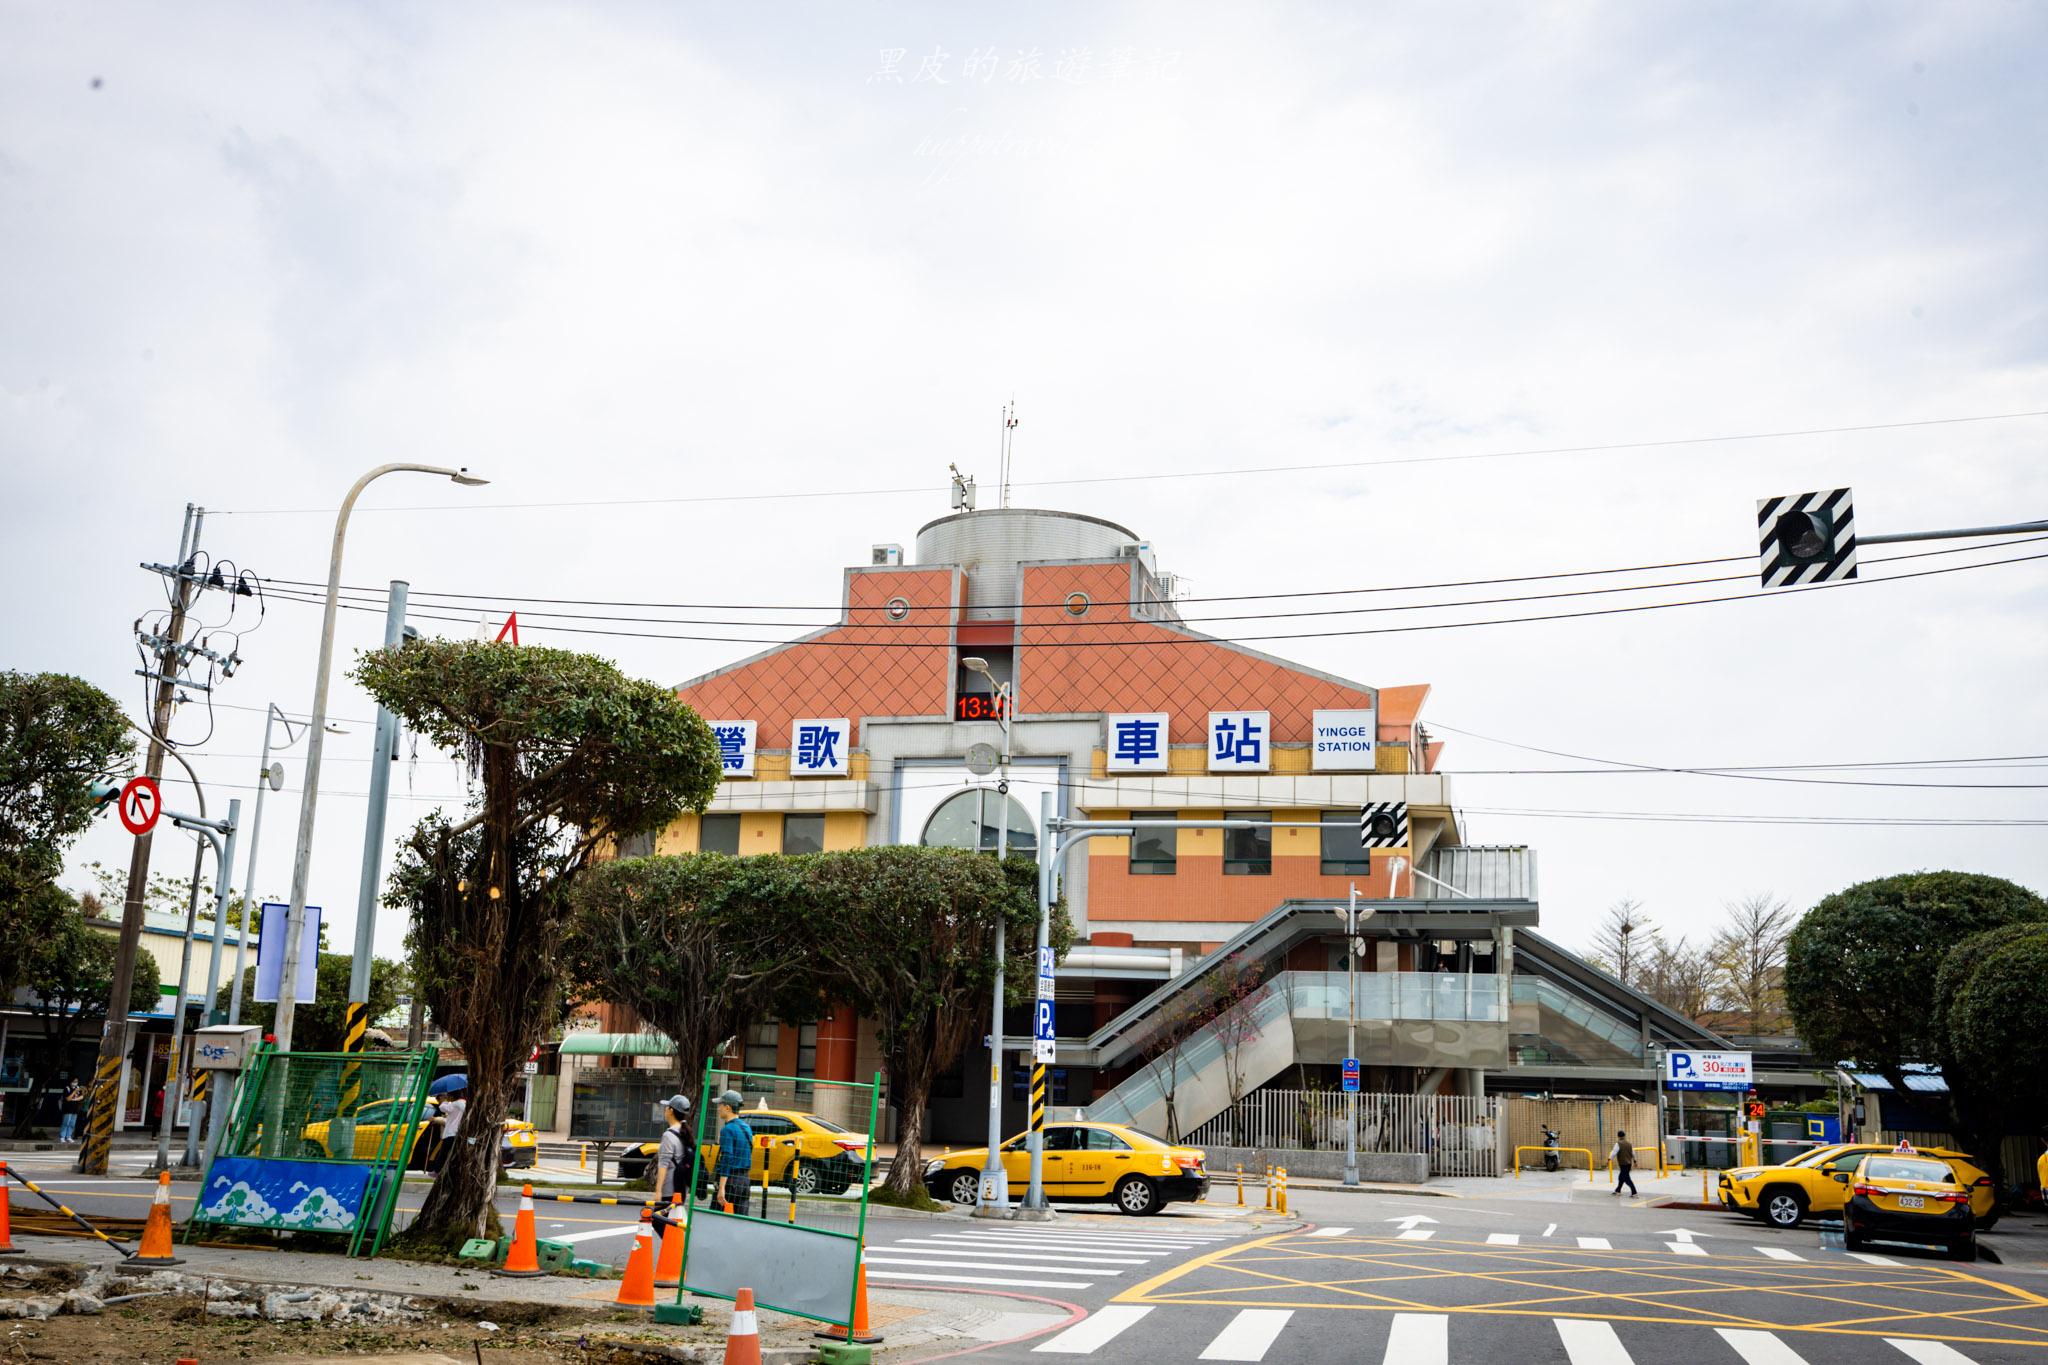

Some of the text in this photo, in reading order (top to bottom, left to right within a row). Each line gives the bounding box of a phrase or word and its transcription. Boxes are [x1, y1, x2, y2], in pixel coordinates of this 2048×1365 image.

[1318, 727, 1366, 737] YINGGE
[1318, 742, 1371, 752] STATION
[1039, 1002, 1051, 1036] P
[1671, 1053, 1692, 1078] P
[1703, 1061, 1719, 1072] 30
[1750, 1104, 1763, 1116] 24
